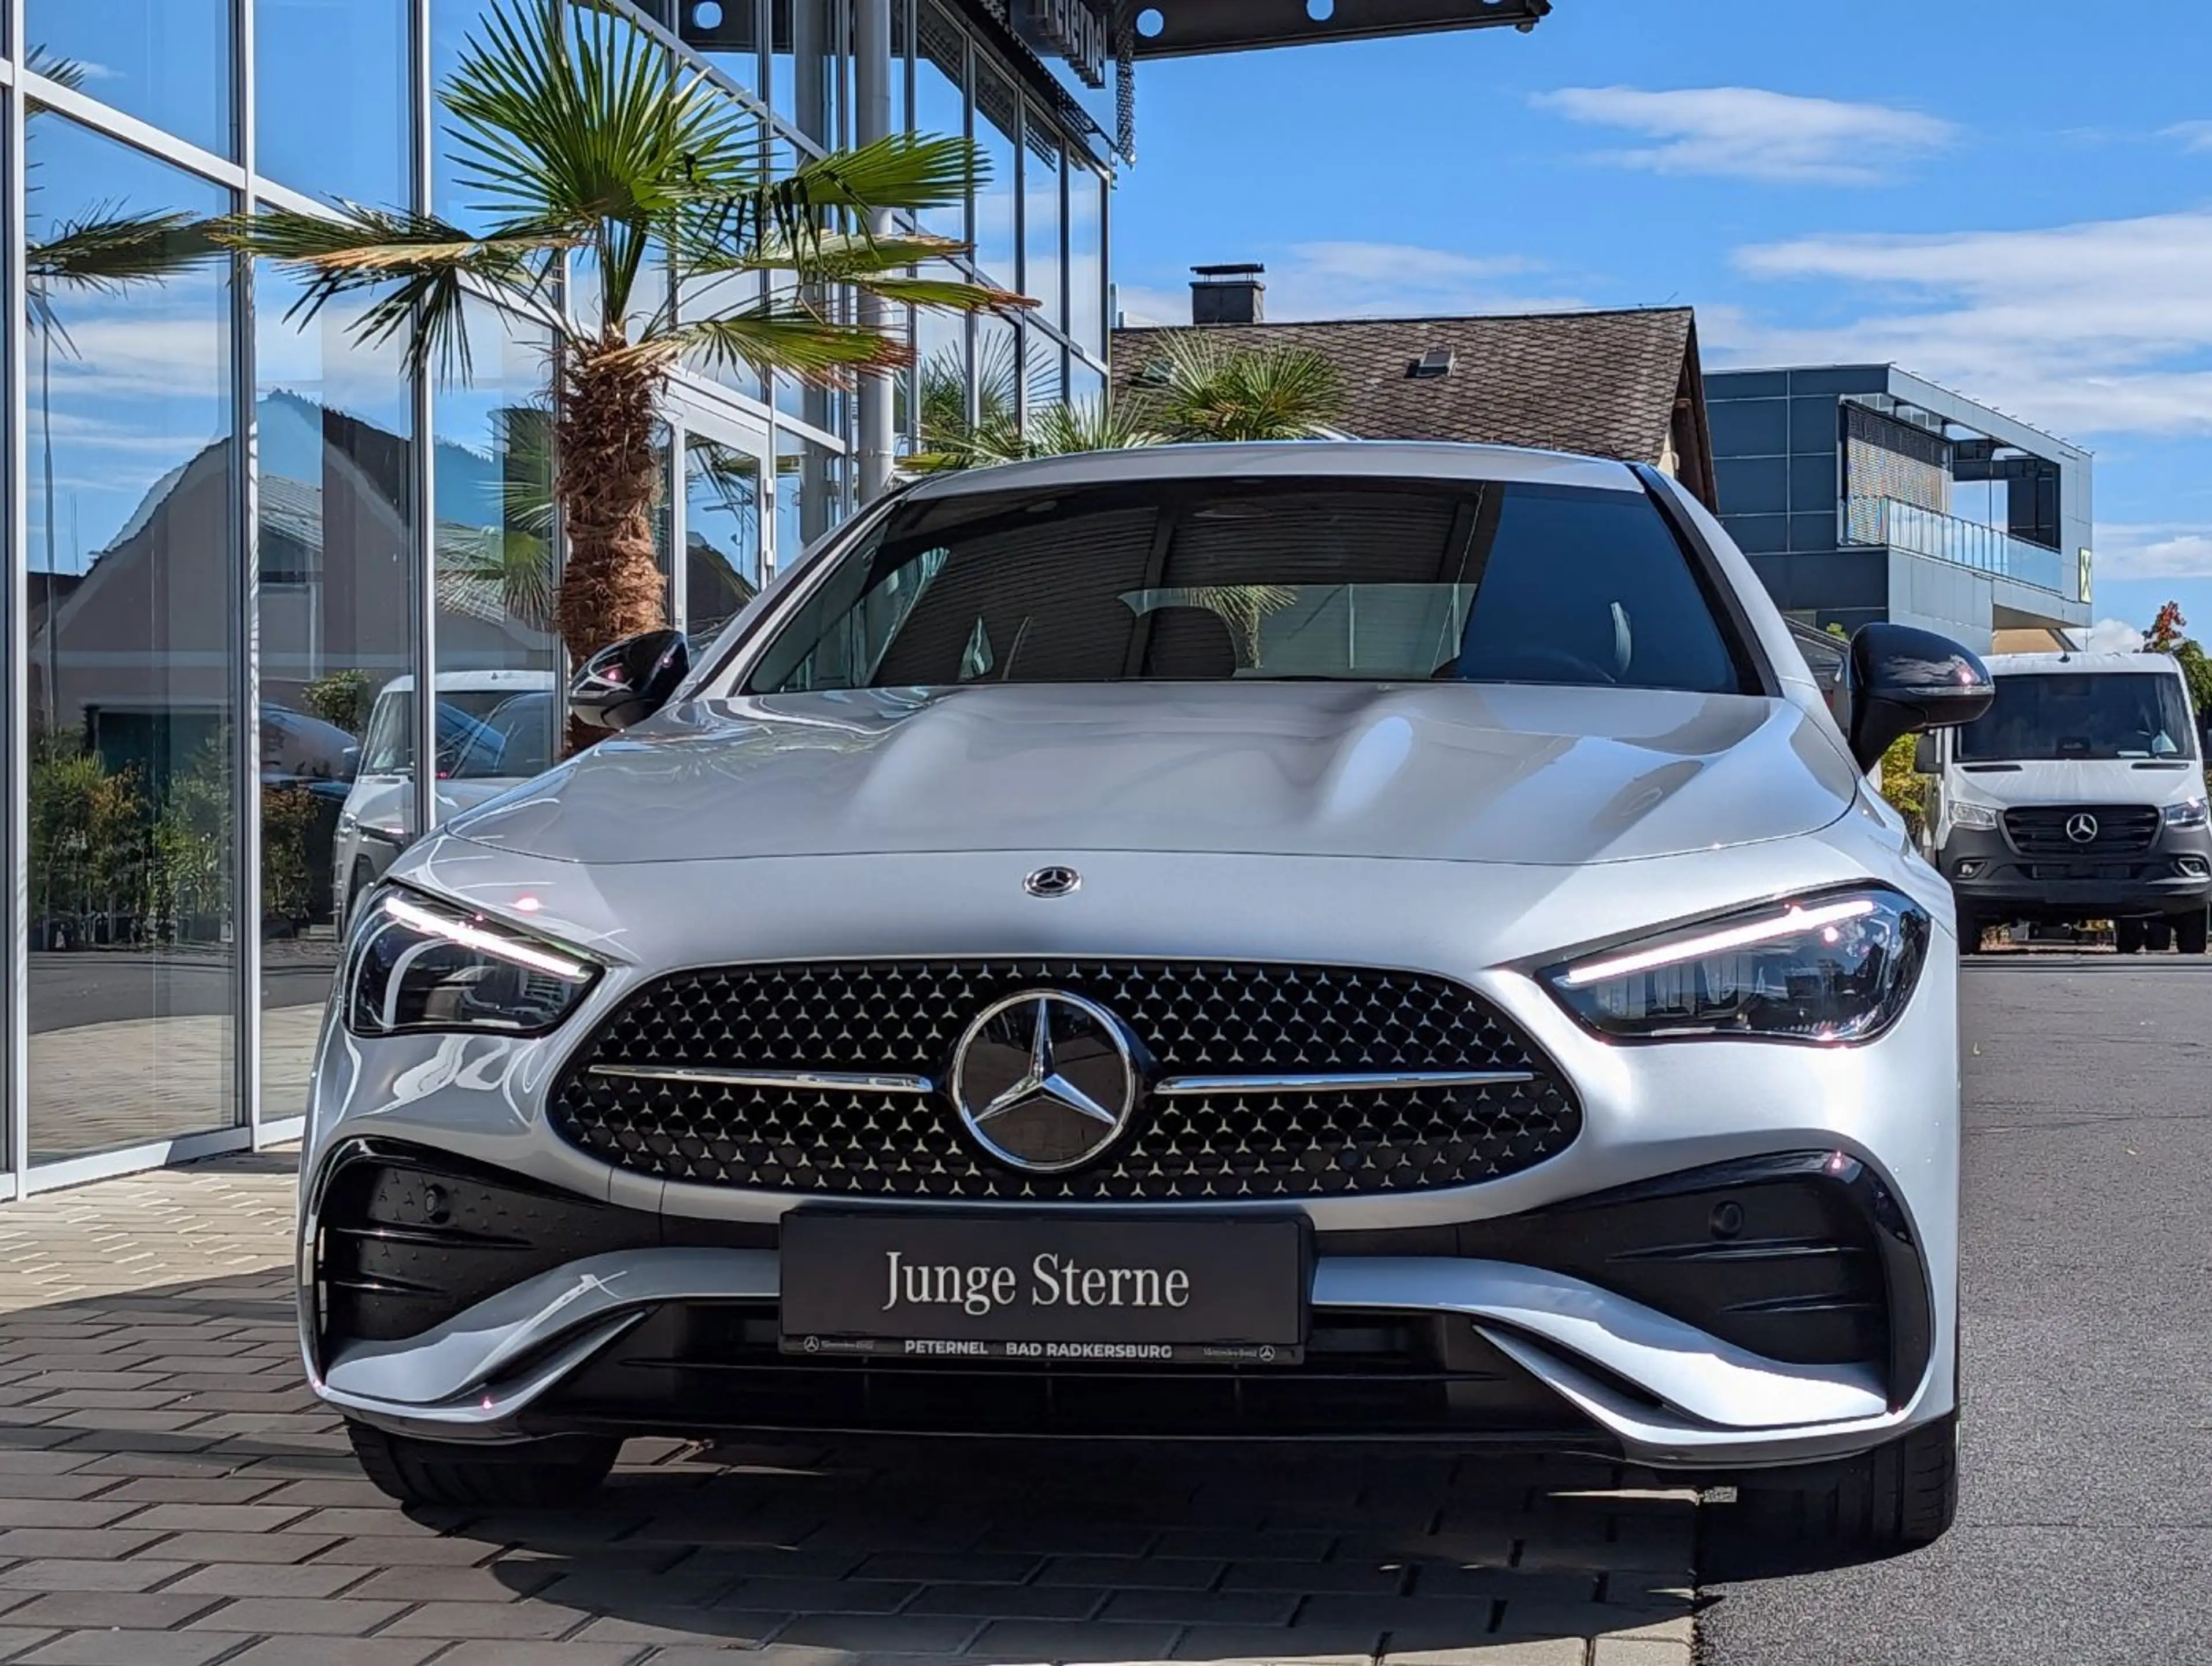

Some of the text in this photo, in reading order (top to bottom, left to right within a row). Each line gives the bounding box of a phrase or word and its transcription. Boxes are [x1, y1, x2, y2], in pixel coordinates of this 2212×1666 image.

[882, 1251, 1189, 1315] Junge Sterne
[904, 1340, 1172, 1359] PETERNEL BAD RADKERSBURG
